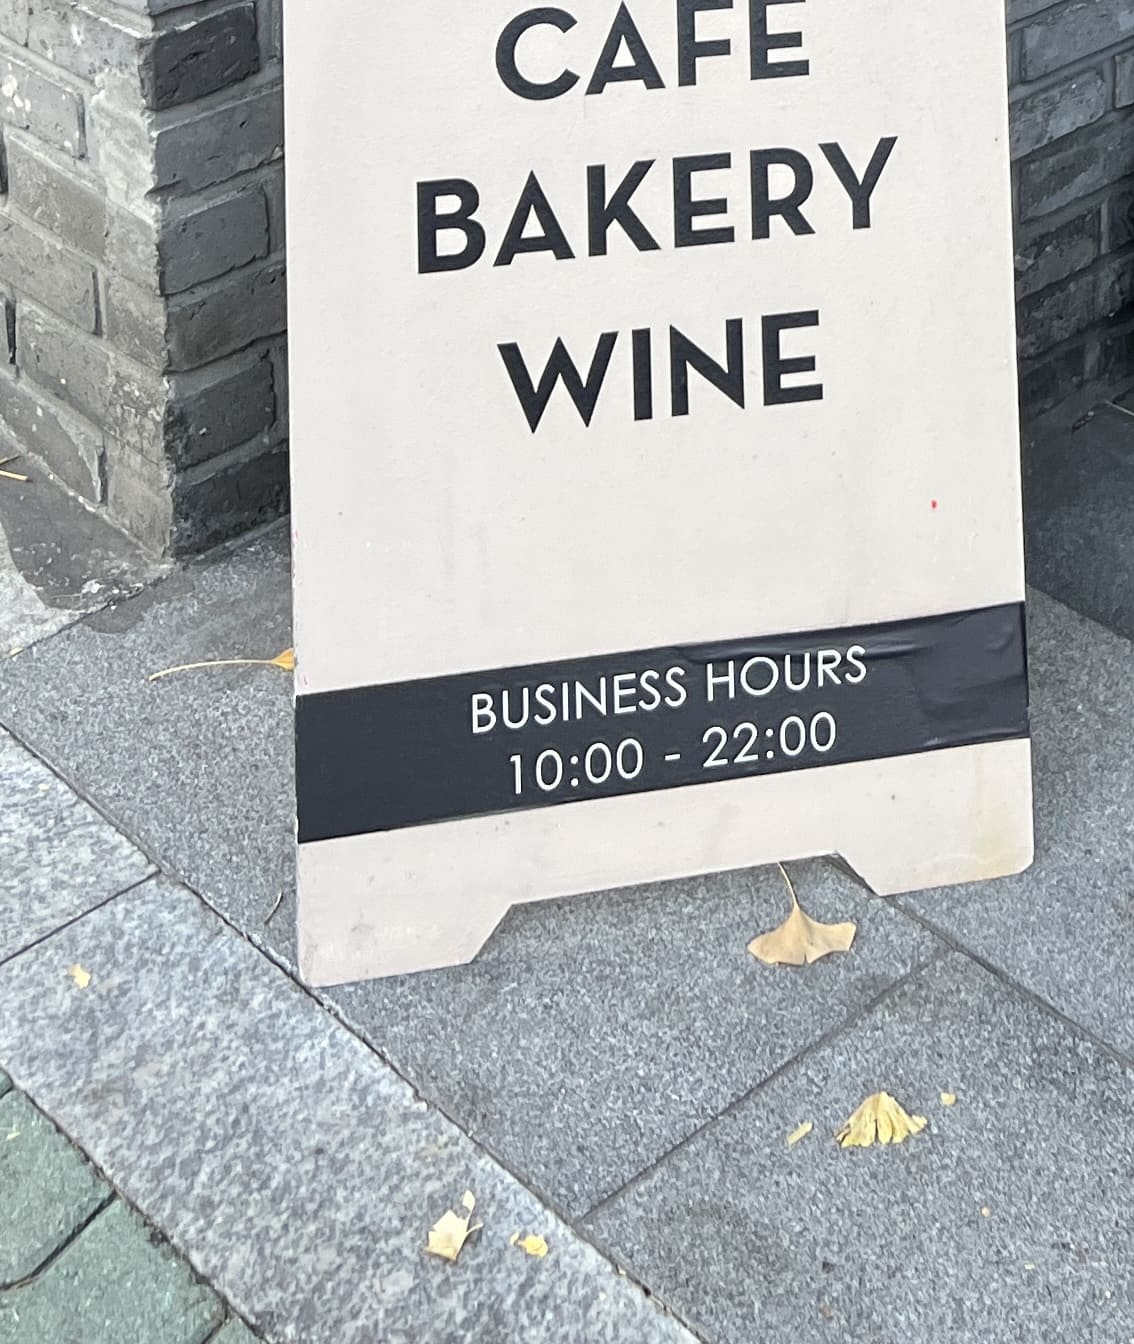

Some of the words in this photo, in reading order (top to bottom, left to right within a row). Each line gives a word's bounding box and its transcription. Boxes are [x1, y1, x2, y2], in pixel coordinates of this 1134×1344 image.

[416, 135, 898, 275] BAKERY
[497, 309, 824, 434] WINE
[470, 666, 688, 735] BUSINESS
[706, 644, 869, 702] HOURS
[508, 738, 645, 795] 10:00
[664, 752, 682, 762] -
[702, 711, 838, 769] 22:00
